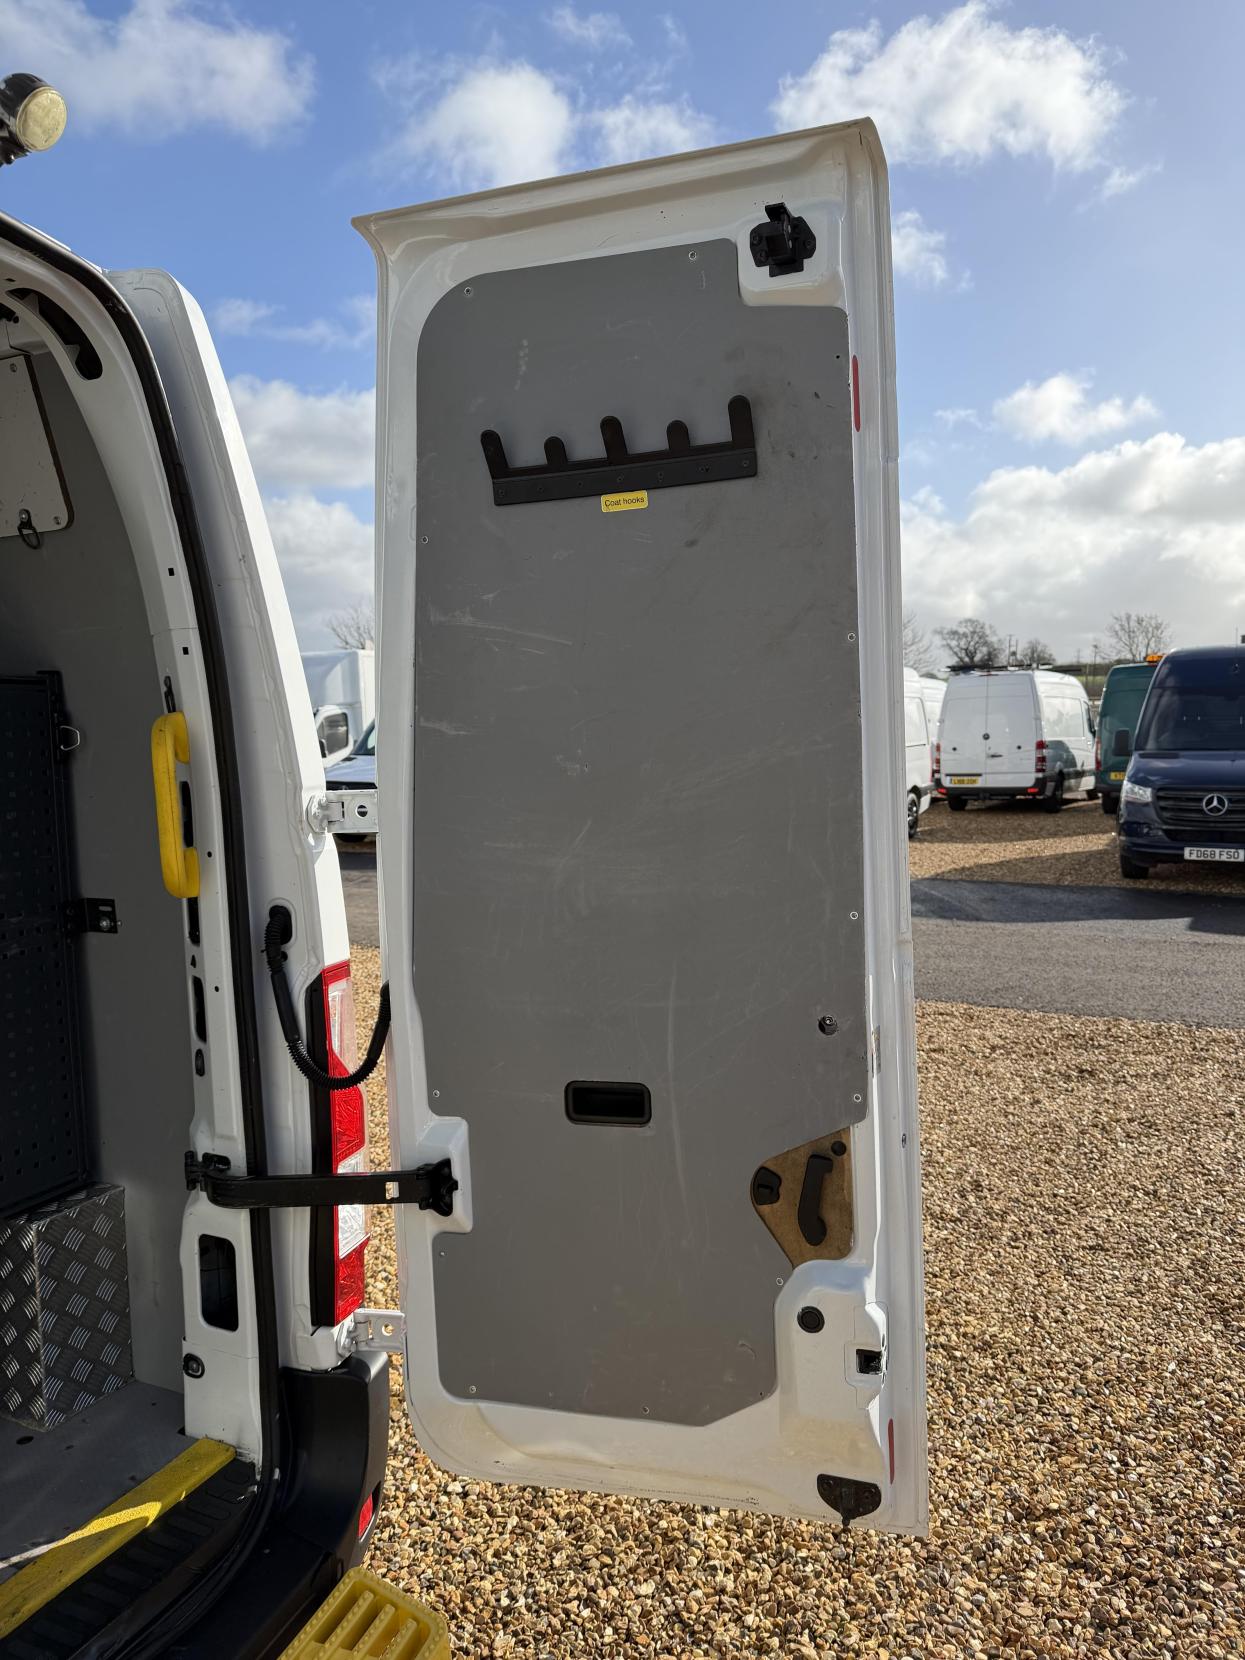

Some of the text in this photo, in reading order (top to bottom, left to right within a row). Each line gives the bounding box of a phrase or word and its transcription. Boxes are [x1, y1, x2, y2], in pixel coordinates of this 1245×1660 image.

[604, 496, 645, 507] Coat hooks
[1189, 849, 1240, 860] FD68 FSO
